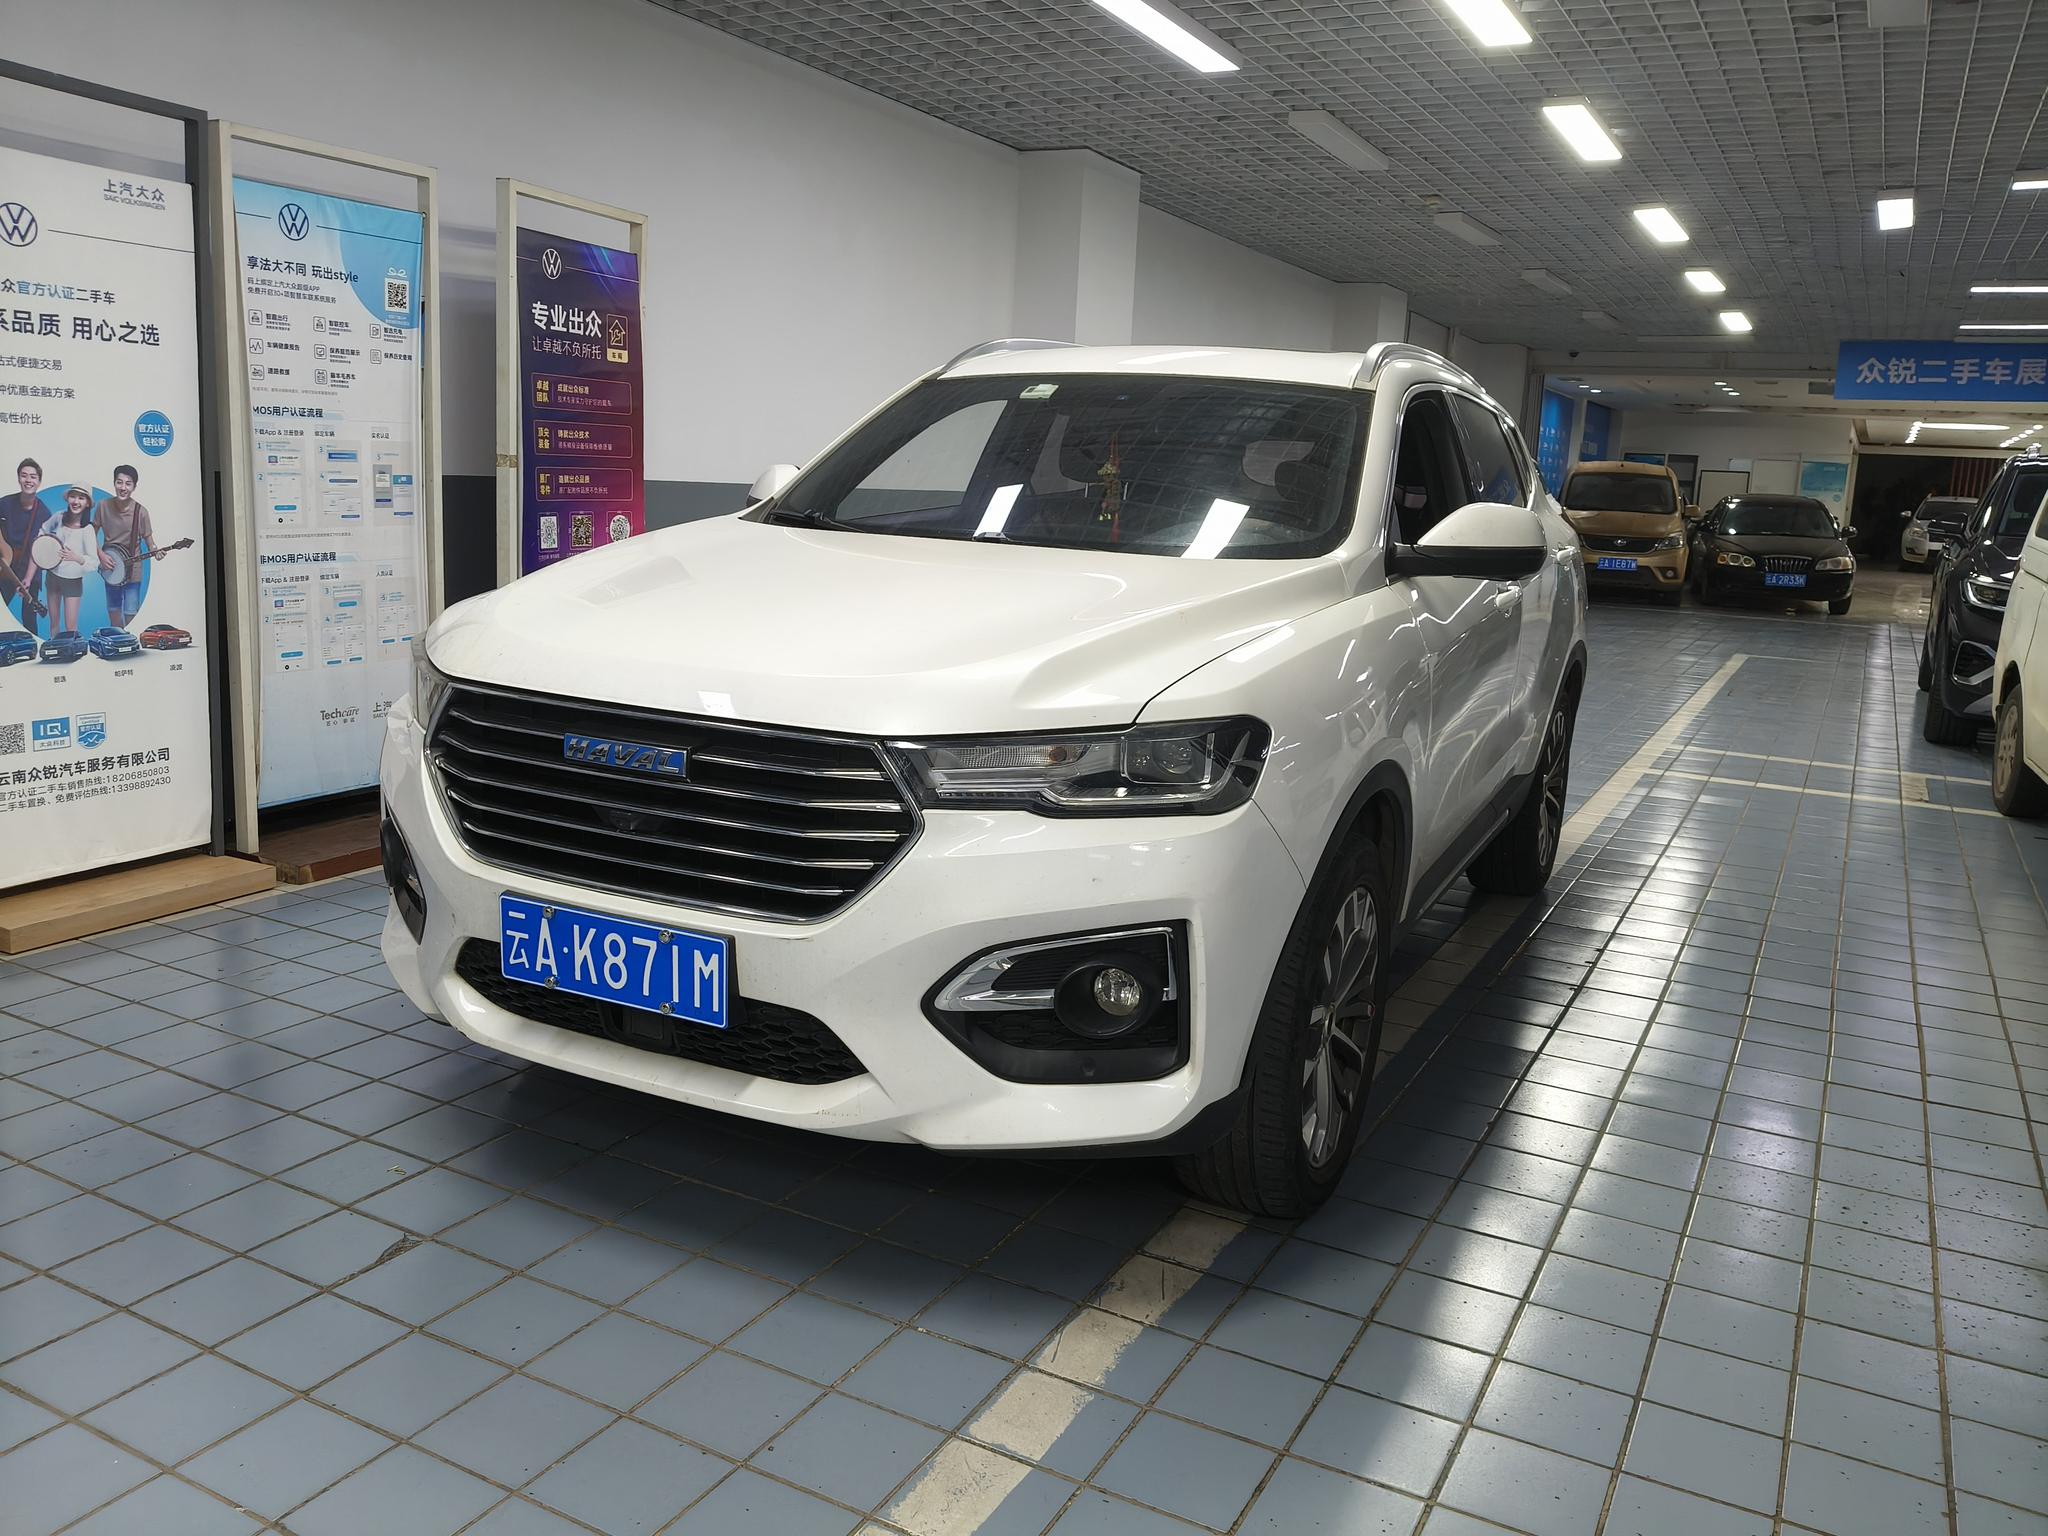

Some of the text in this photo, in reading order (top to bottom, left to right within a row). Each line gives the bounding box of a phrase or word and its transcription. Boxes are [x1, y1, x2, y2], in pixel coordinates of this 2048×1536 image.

[103, 179, 165, 203] 上汽大众
[247, 255, 359, 284] 享法大不同 玩出style
[1, 278, 116, 304] 众官方认证二手车
[72, 316, 160, 347] 用心之选
[531, 301, 602, 338] 专业出众
[532, 336, 602, 360] 让卓越不负所托
[1856, 357, 2047, 385] 众锐二手车展
[139, 423, 171, 434] 官方认证
[320, 706, 360, 721] Techcare
[0, 748, 170, 787] 云南众锐汽车服务有限公司
[566, 737, 679, 773] HAVAL
